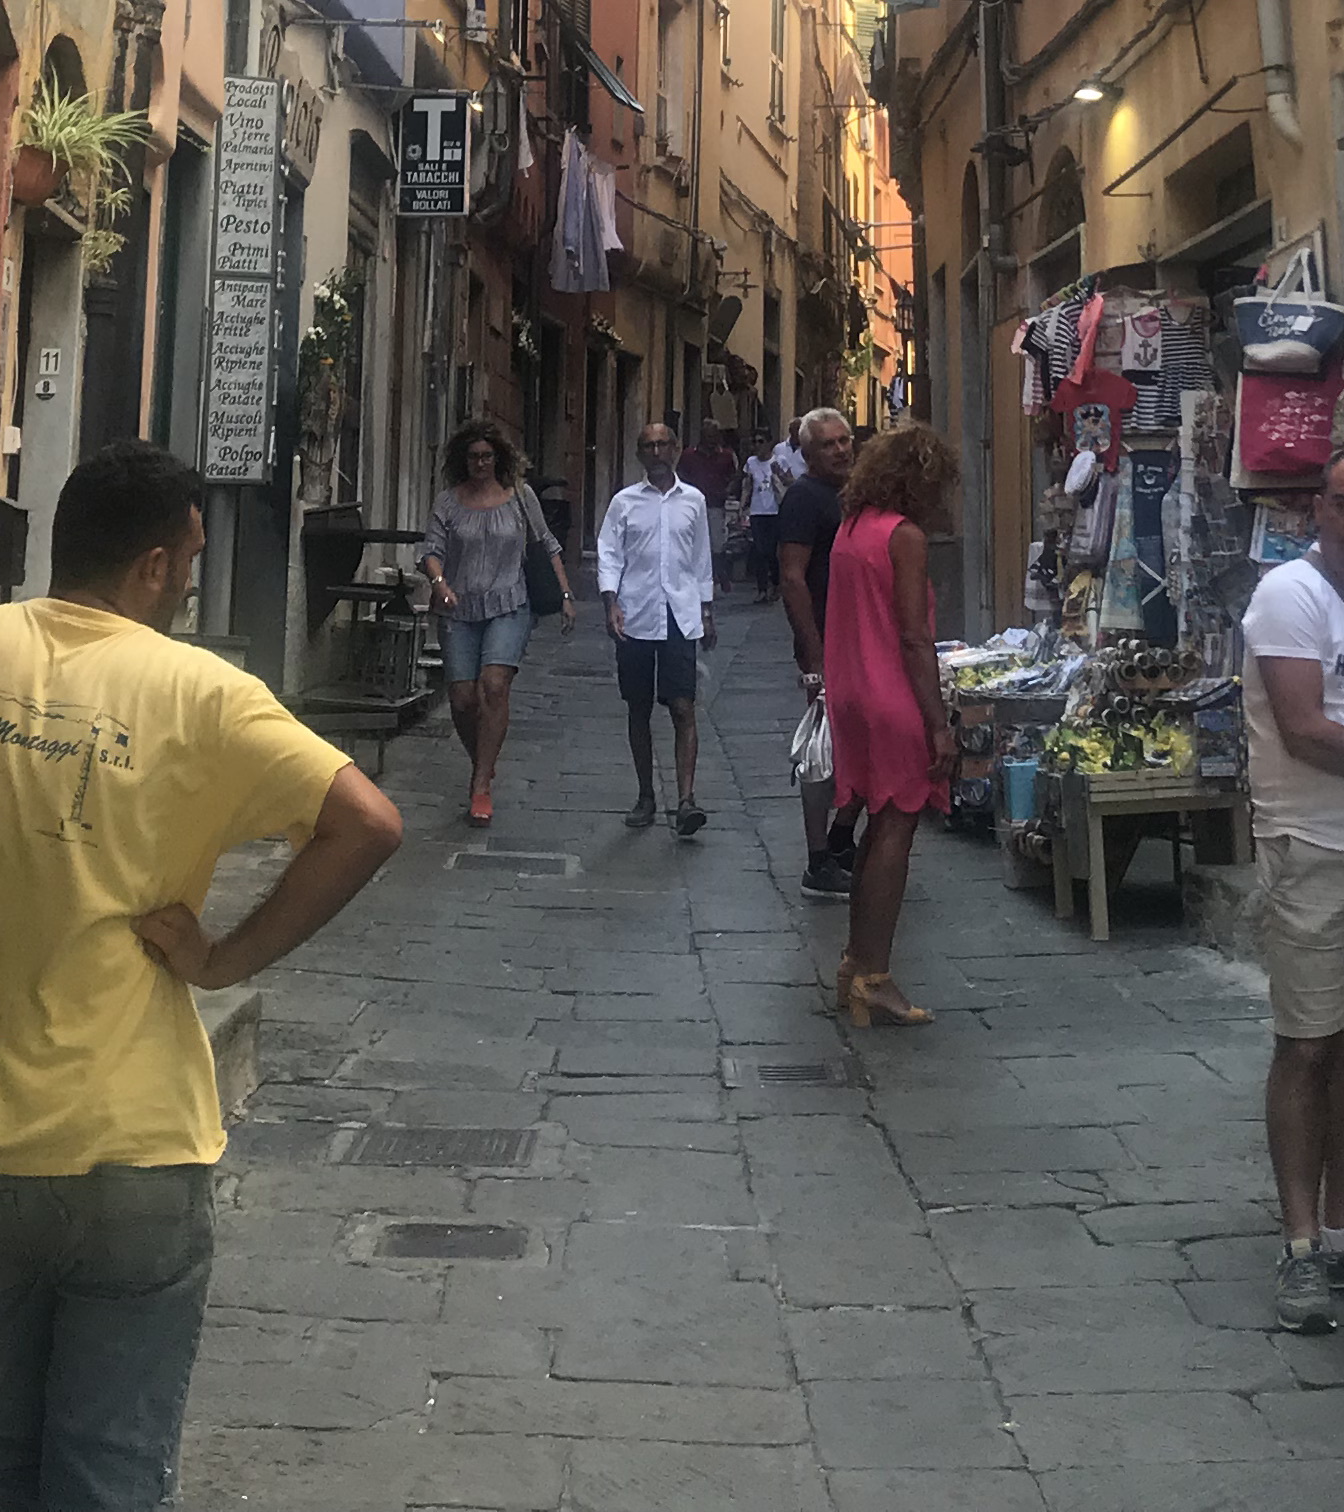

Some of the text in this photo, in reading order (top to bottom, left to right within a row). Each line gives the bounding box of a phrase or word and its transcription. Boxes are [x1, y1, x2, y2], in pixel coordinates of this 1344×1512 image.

[225, 80, 275, 96] Prodotti
[226, 94, 267, 109] Locali
[225, 112, 264, 130] Vino
[241, 130, 271, 143] terre
[413, 99, 456, 161] T
[222, 139, 274, 155] Palmaria
[220, 159, 274, 174] Aperitivi
[418, 163, 439, 171] SALI
[406, 171, 460, 183] TABACCHI
[219, 180, 265, 196] Piatti
[416, 189, 449, 199] VALORI
[231, 193, 268, 212] Tipici
[412, 200, 451, 210] BOLLATI
[219, 213, 271, 235] Pesto
[228, 242, 269, 259] Primi
[217, 255, 258, 271] Piatti
[214, 280, 269, 297] Antipasti
[230, 294, 267, 308] Mare
[212, 310, 266, 327] Acciughe
[212, 324, 251, 338] Fritte
[211, 341, 266, 359] Acciughe
[42, 352, 59, 372] 11
[213, 356, 263, 373] Ripiene
[42, 380, 50, 393] 8
[218, 391, 263, 406] Patate
[208, 410, 263, 425] Muscoli
[218, 444, 263, 466] Polpo
[206, 463, 249, 477] Patate
